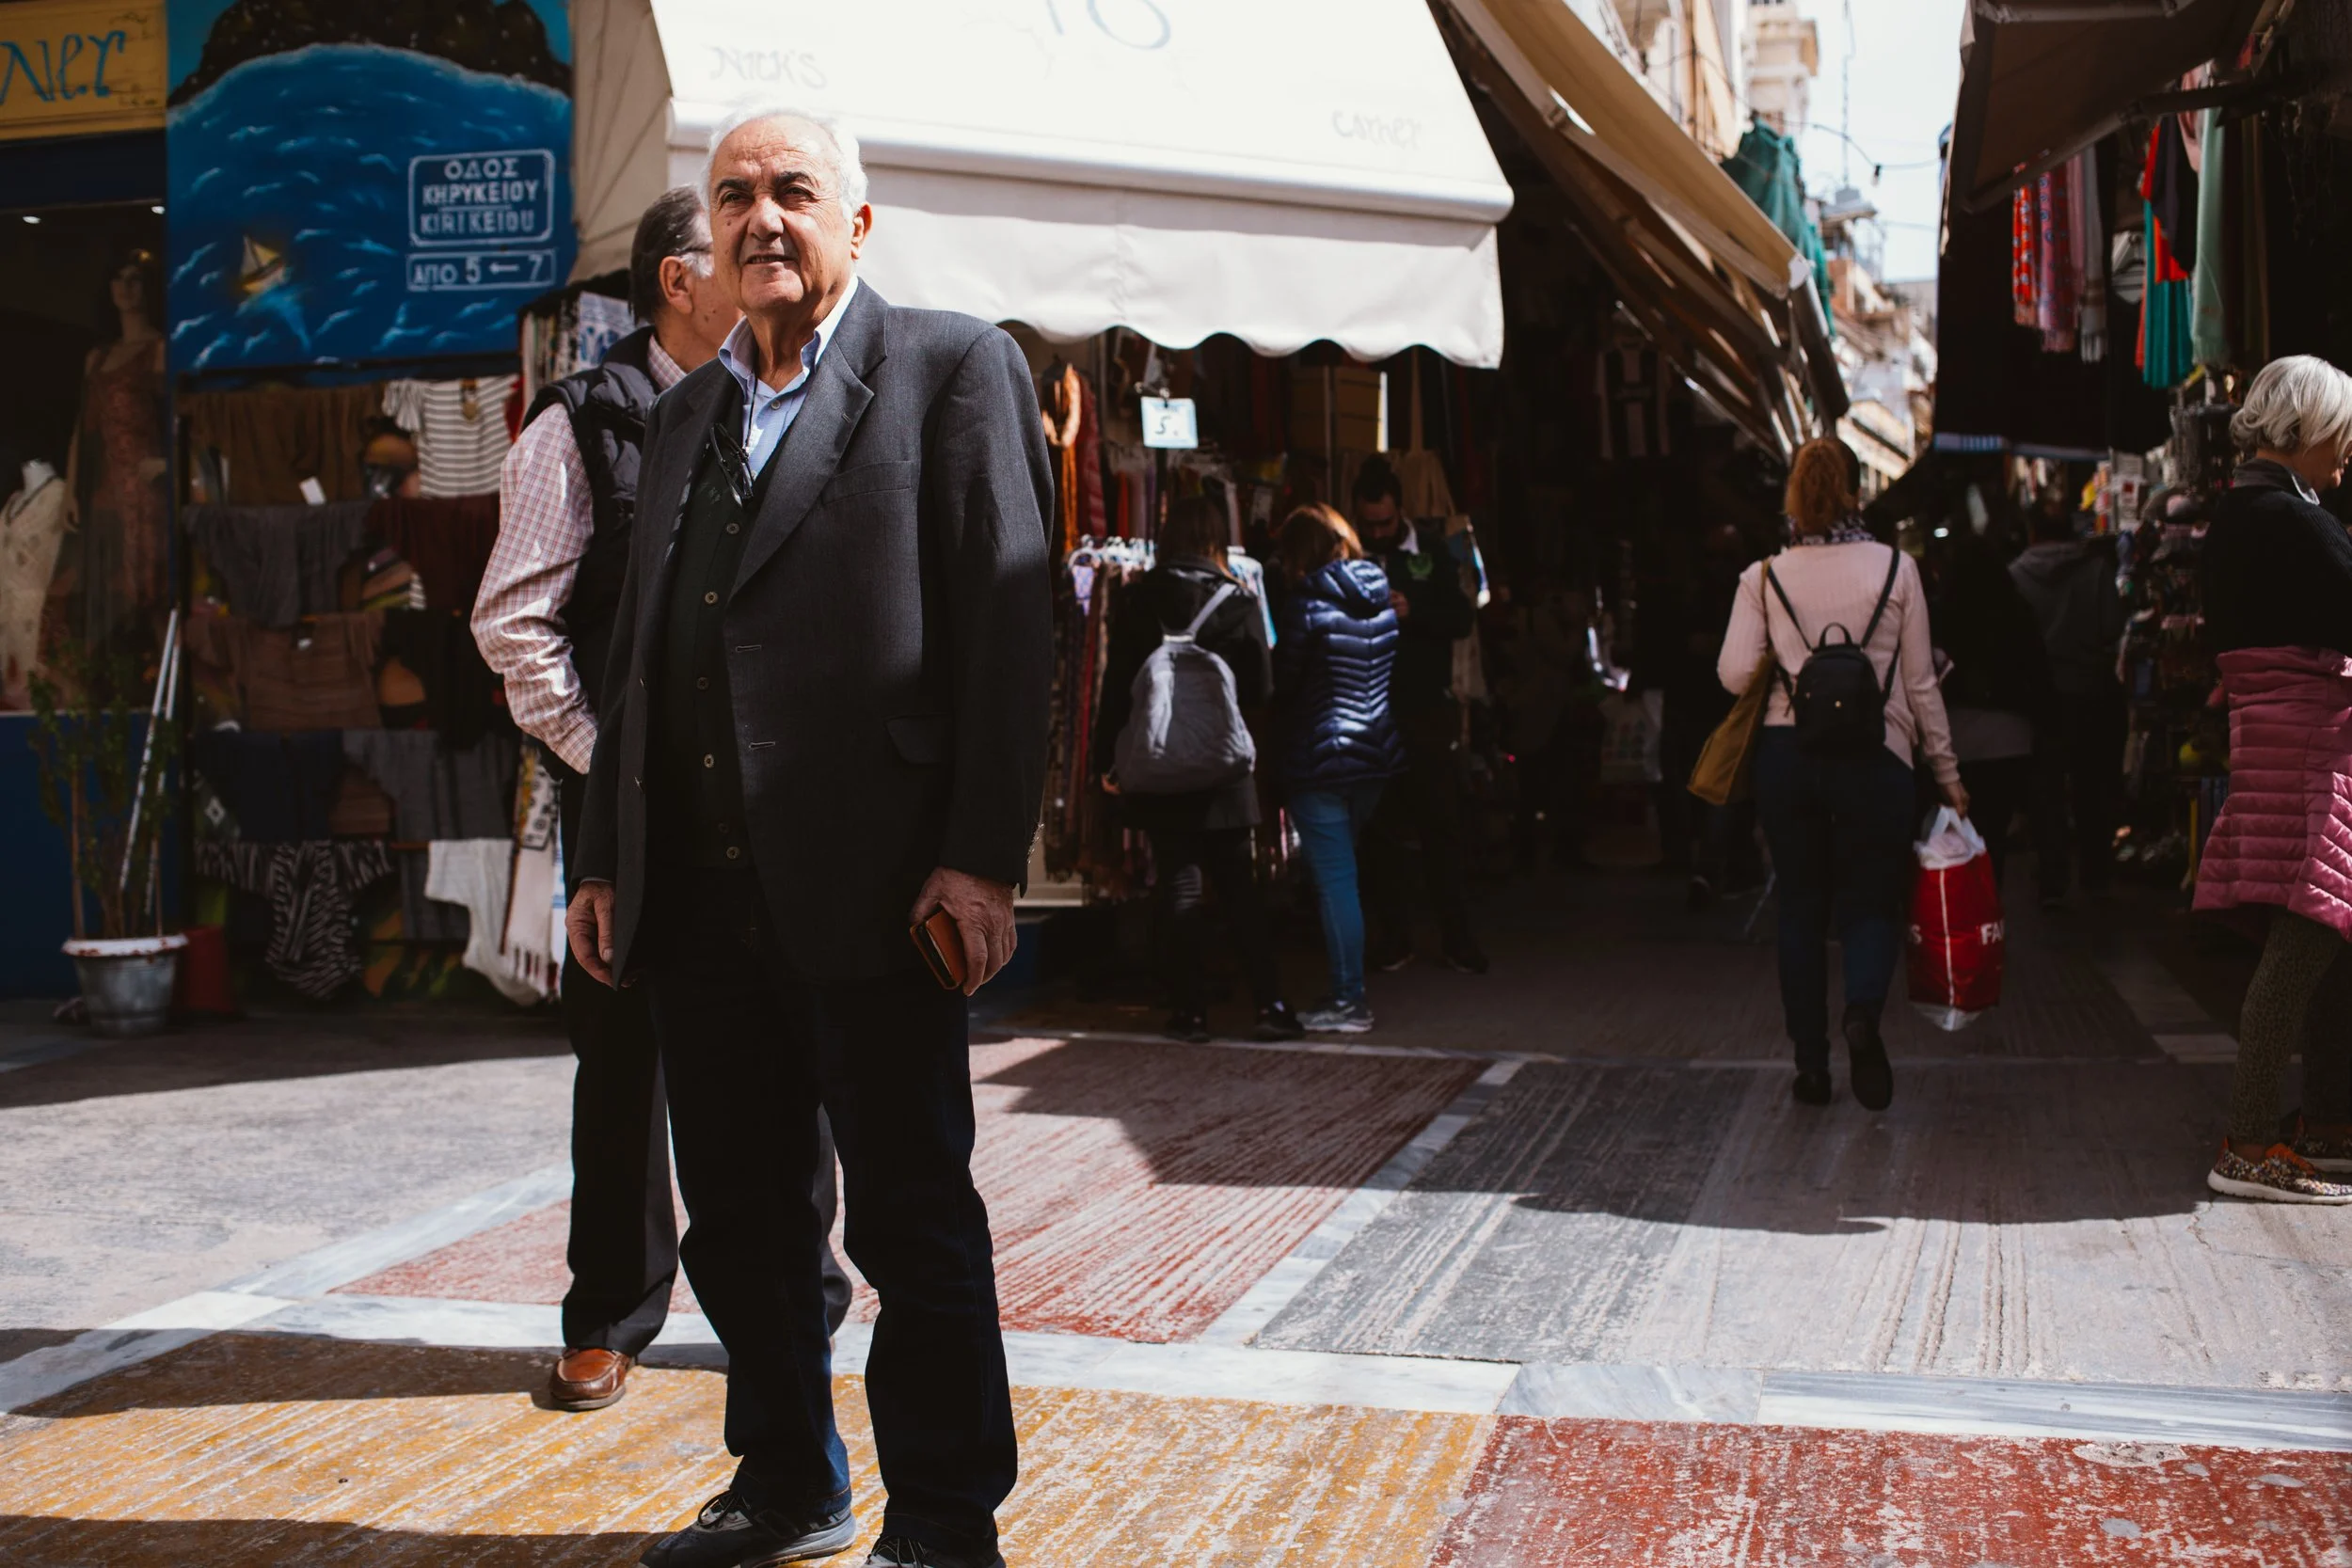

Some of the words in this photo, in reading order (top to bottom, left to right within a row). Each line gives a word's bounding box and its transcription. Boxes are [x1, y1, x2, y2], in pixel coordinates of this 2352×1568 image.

[443, 157, 519, 181] ΟΔΟΣ
[422, 179, 539, 206] ΚΗΡΥΚΕΙΟΥ
[420, 209, 535, 235] KIRIKEIOU
[413, 262, 458, 284] ΑΠΟ
[465, 255, 482, 284] 5
[528, 253, 544, 281] 7
